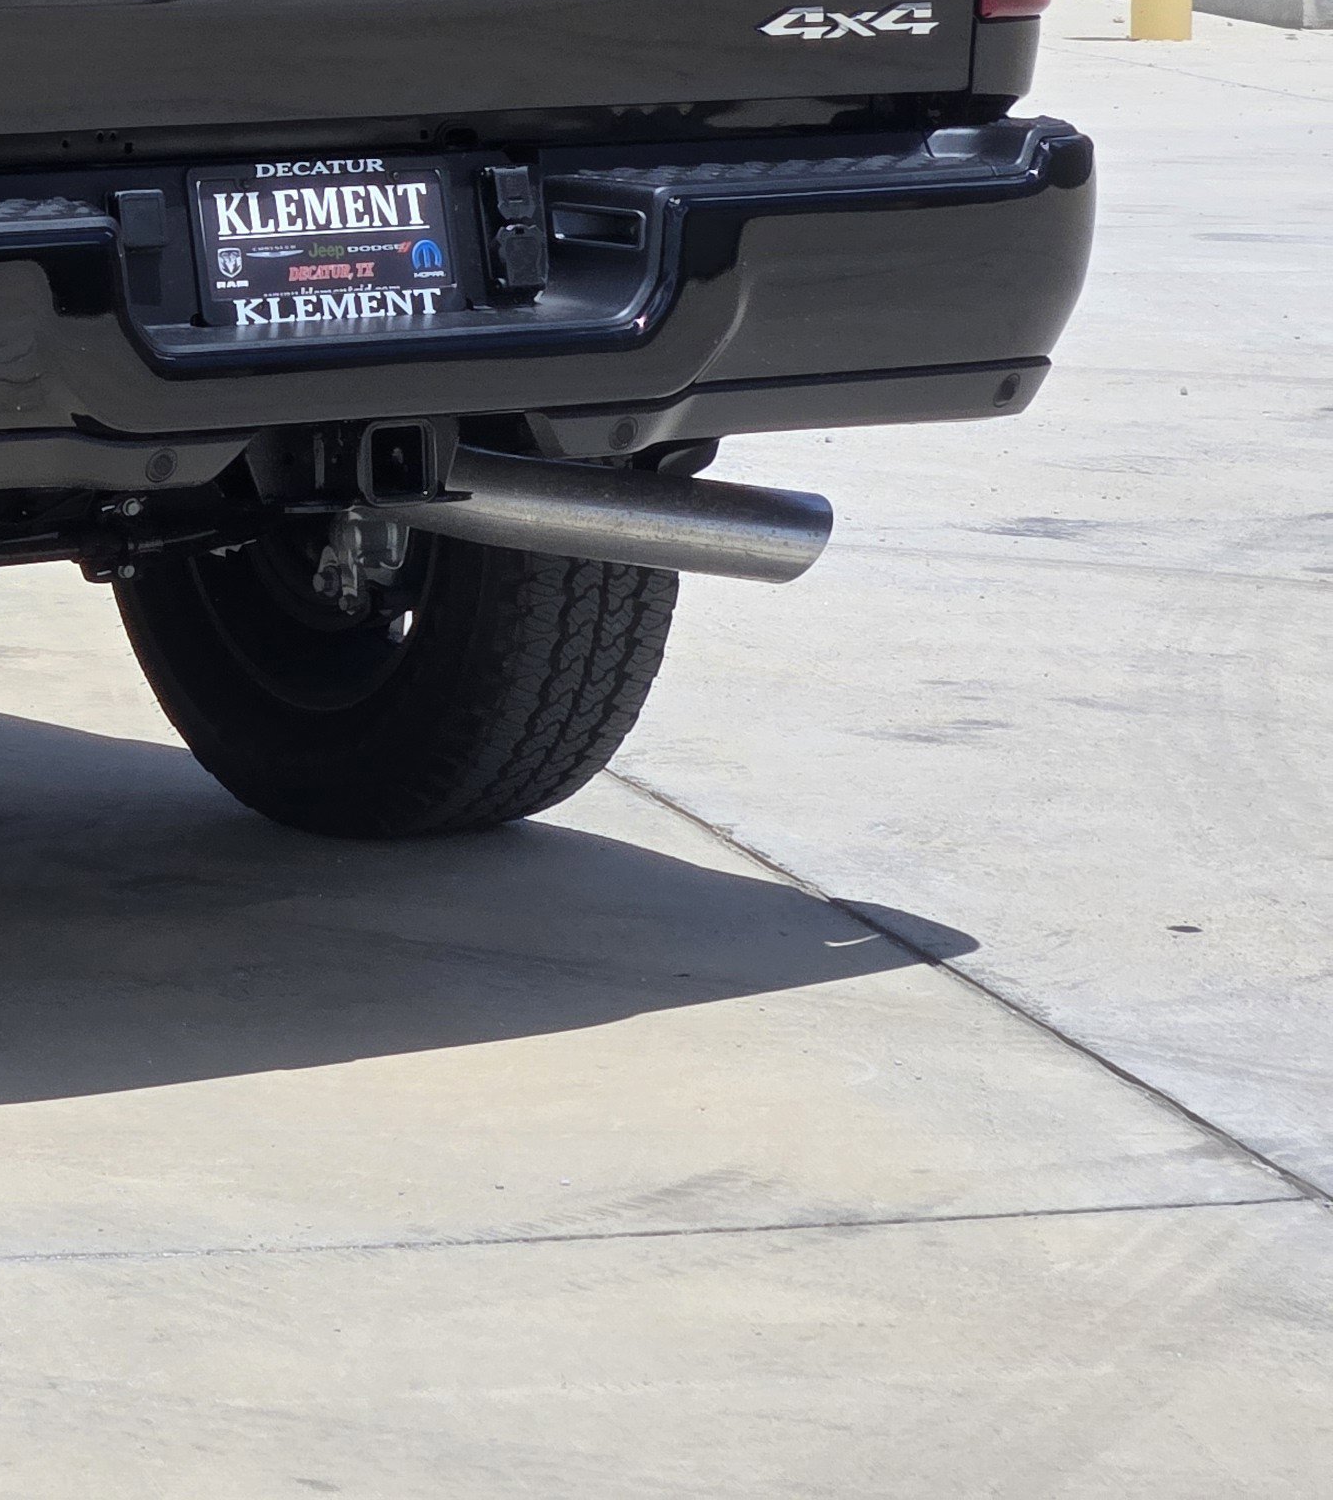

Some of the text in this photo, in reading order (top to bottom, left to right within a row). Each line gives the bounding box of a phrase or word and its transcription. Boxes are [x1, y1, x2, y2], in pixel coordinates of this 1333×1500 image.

[757, 2, 938, 40] 4x4
[255, 158, 386, 179] DECATUR
[213, 183, 427, 235] KLEMENT
[308, 242, 345, 258] Jeep
[233, 288, 441, 325] KLEMENT
